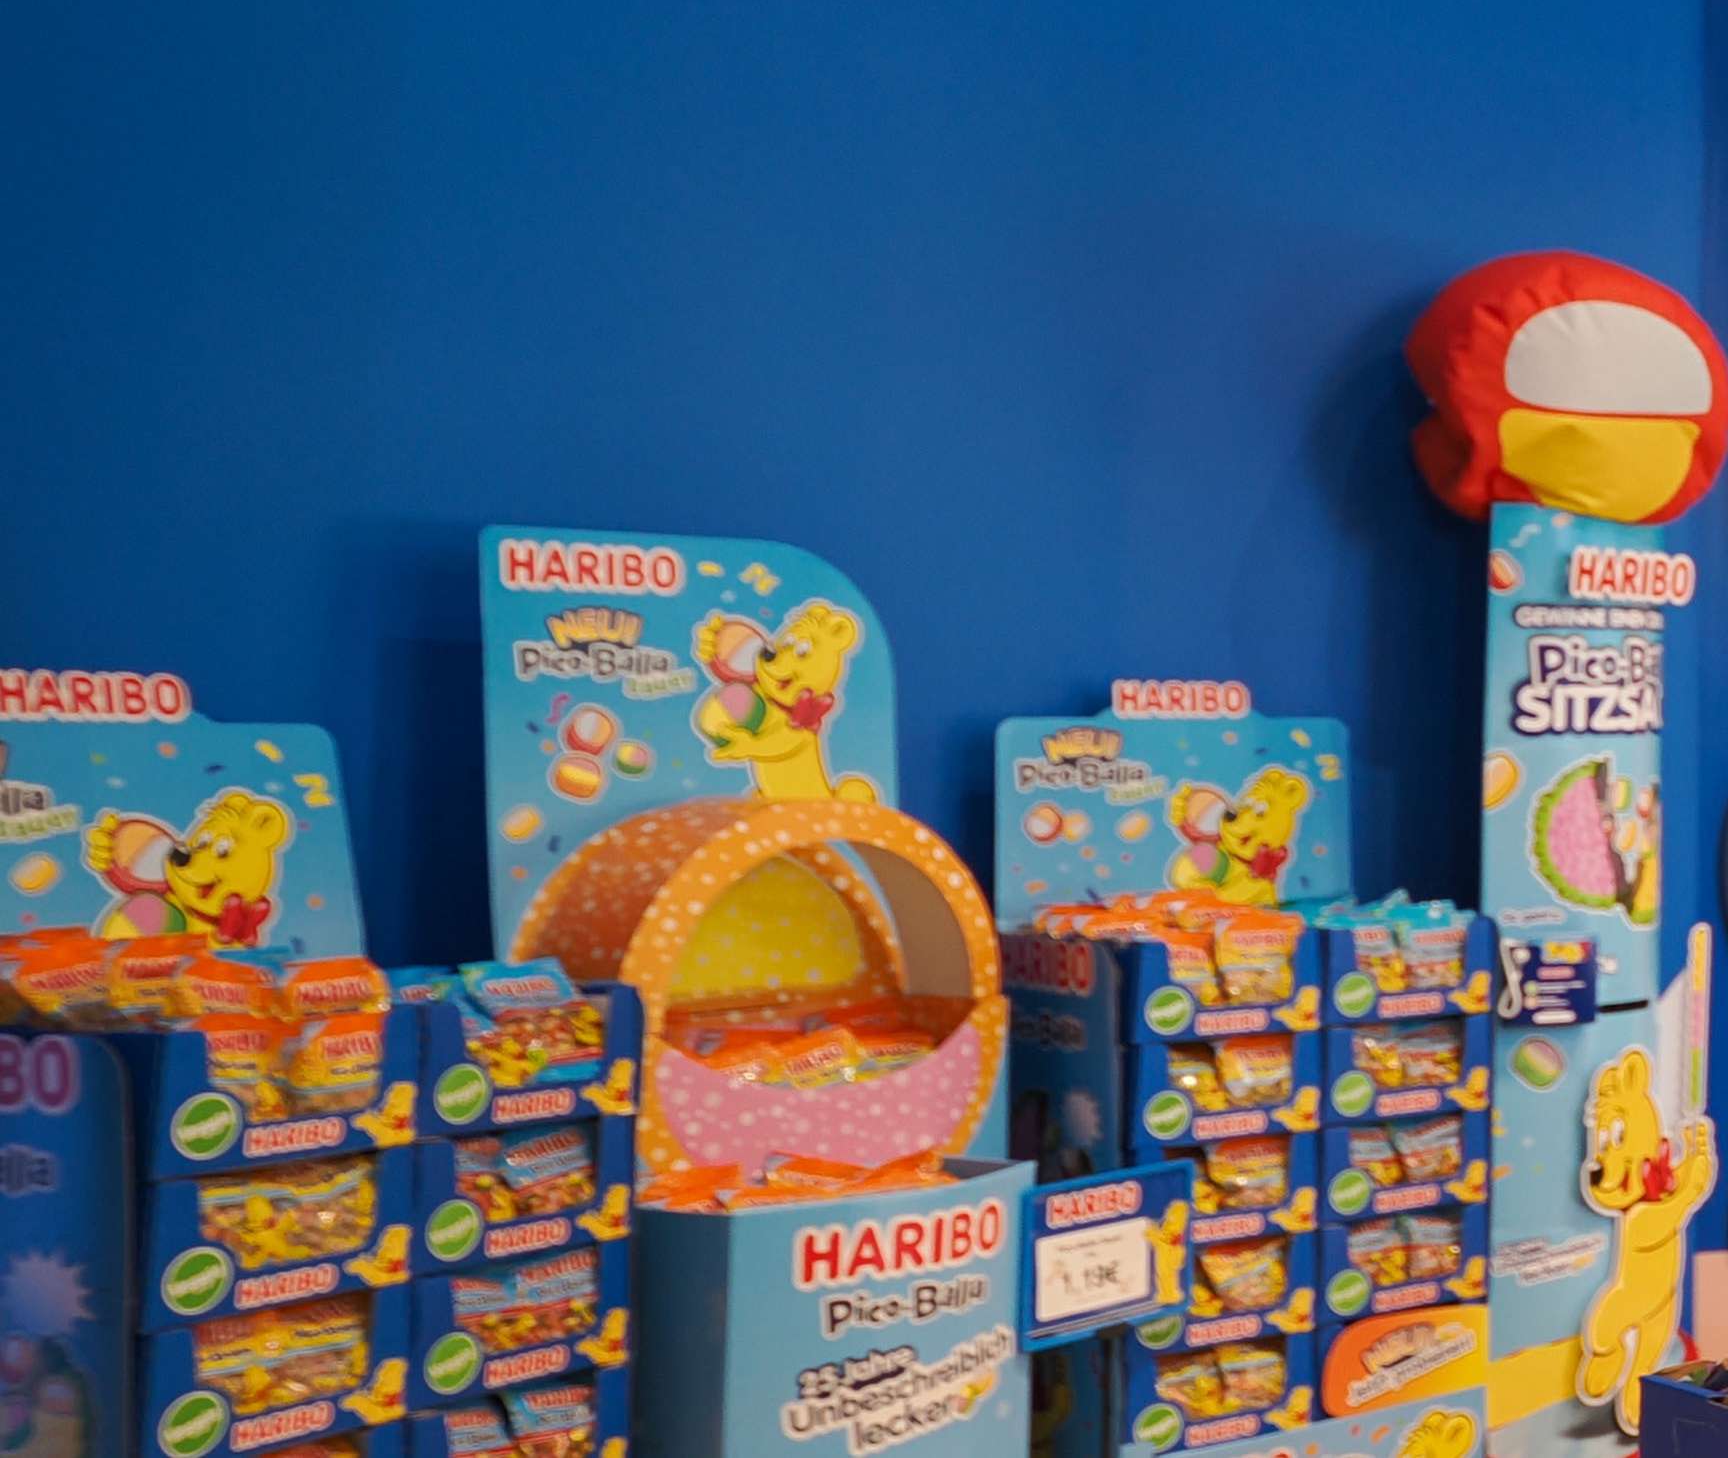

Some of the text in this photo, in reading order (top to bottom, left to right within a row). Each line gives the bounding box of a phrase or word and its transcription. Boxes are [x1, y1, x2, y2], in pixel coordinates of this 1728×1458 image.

[505, 544, 680, 591] HARIBO
[1575, 550, 1691, 600] HARIBO
[0, 672, 185, 718] HARIBO
[1117, 684, 1246, 715] HARIBO
[246, 1120, 343, 1155] HARIBO
[801, 1202, 1002, 1286] HARIBO
[236, 1267, 334, 1307] HARIBO
[232, 1403, 331, 1449] HARIBO
